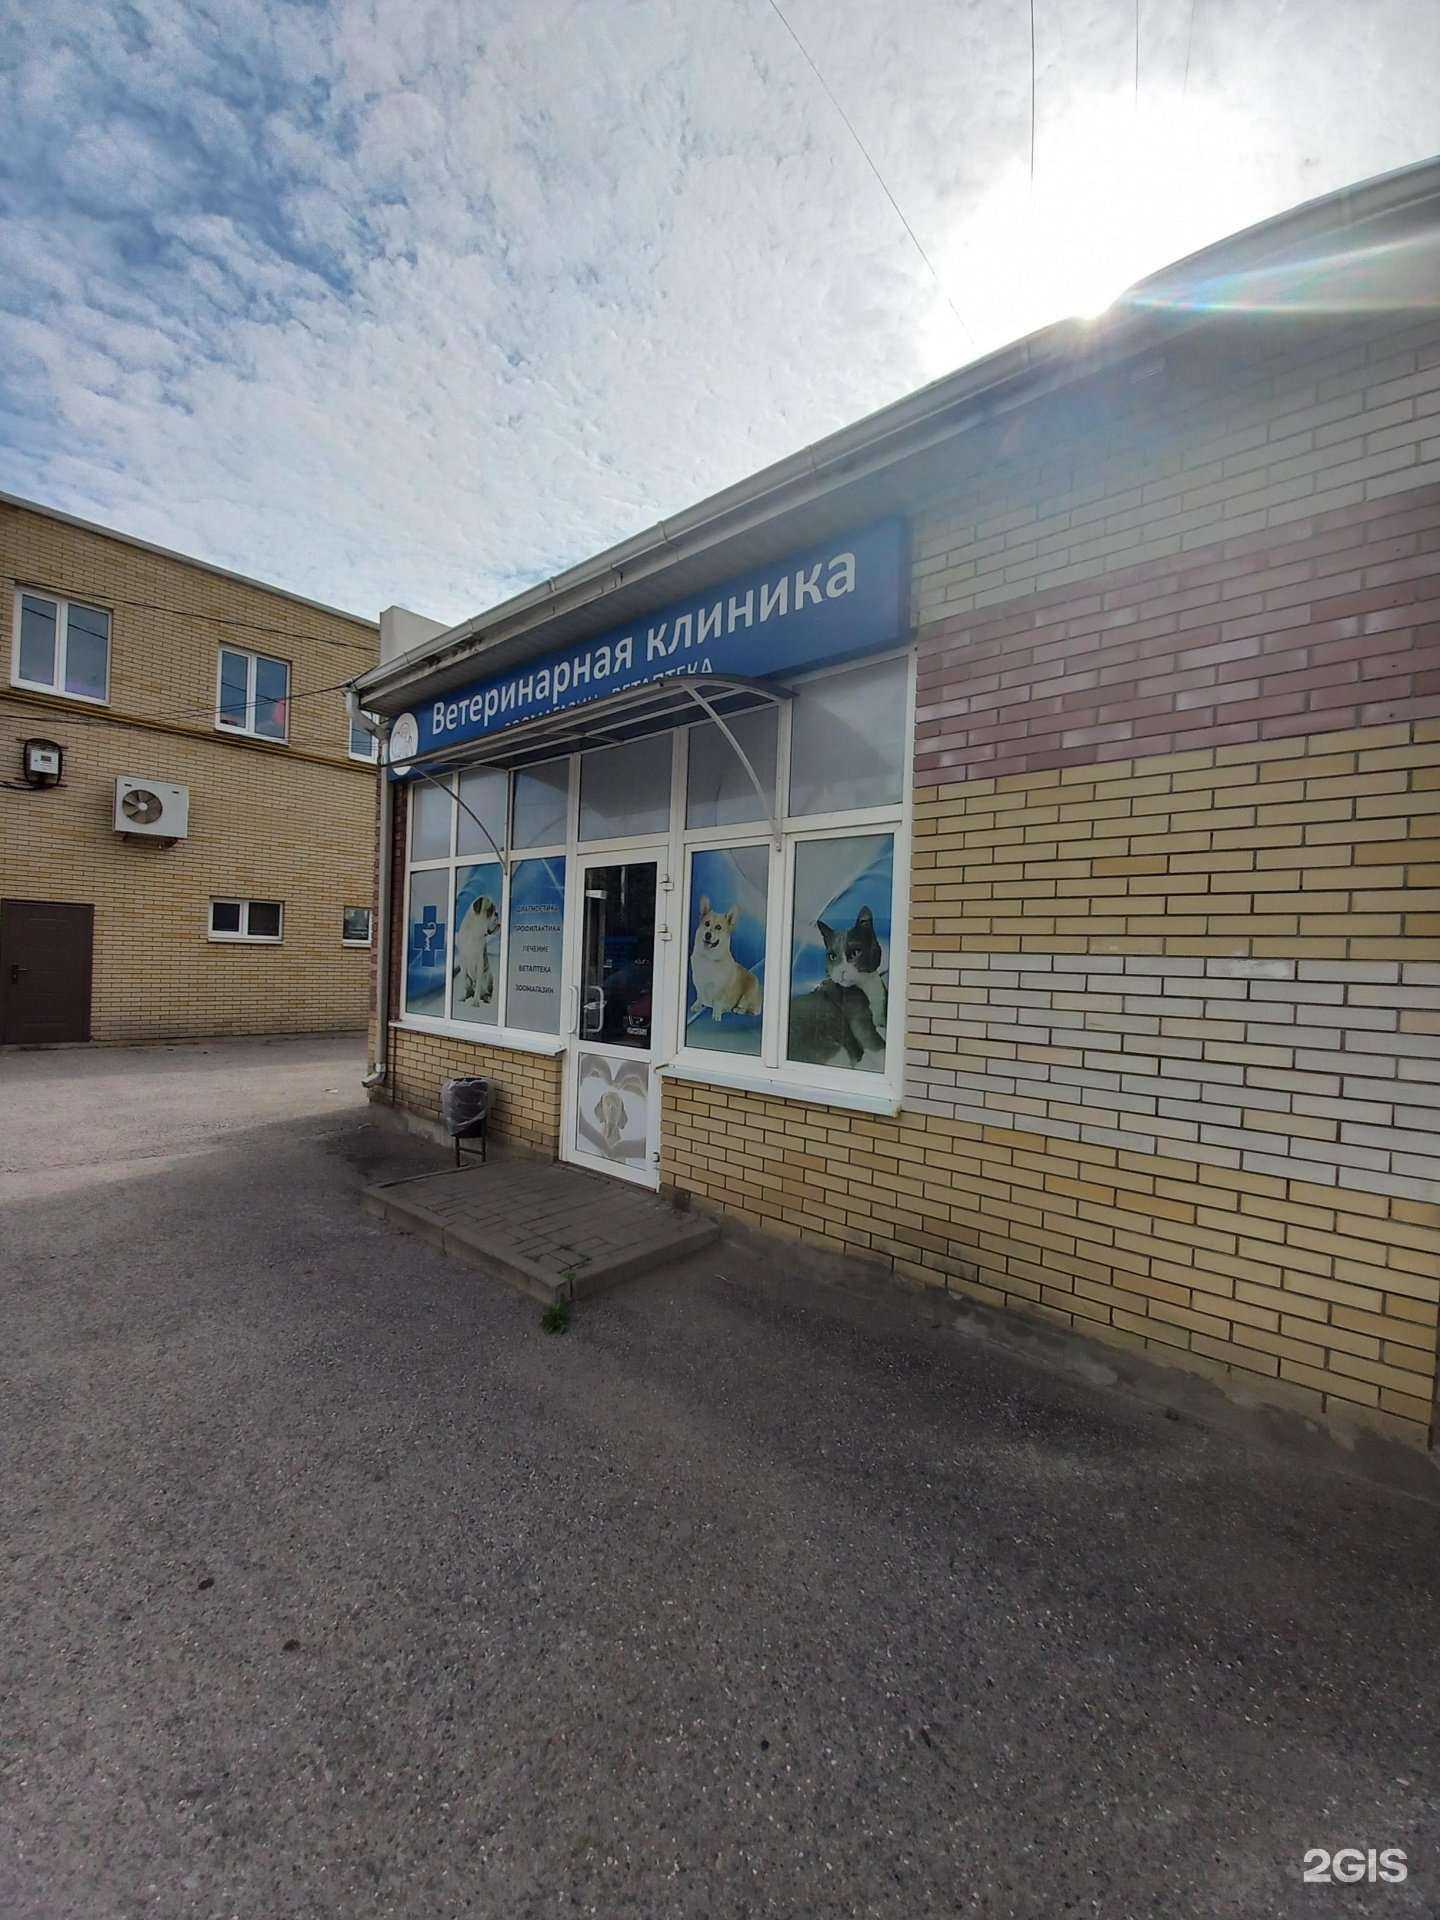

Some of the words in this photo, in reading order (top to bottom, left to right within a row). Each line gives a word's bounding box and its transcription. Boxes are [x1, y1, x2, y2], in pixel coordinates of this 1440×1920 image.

[432, 636, 633, 735] Ветеринарная
[647, 552, 856, 661] клиника
[521, 944, 550, 953] ЛЕЧЕНИЕ
[518, 964, 551, 974] ВЕТАПТЕКА
[515, 983, 554, 994] ЗООМАГАЗИН
